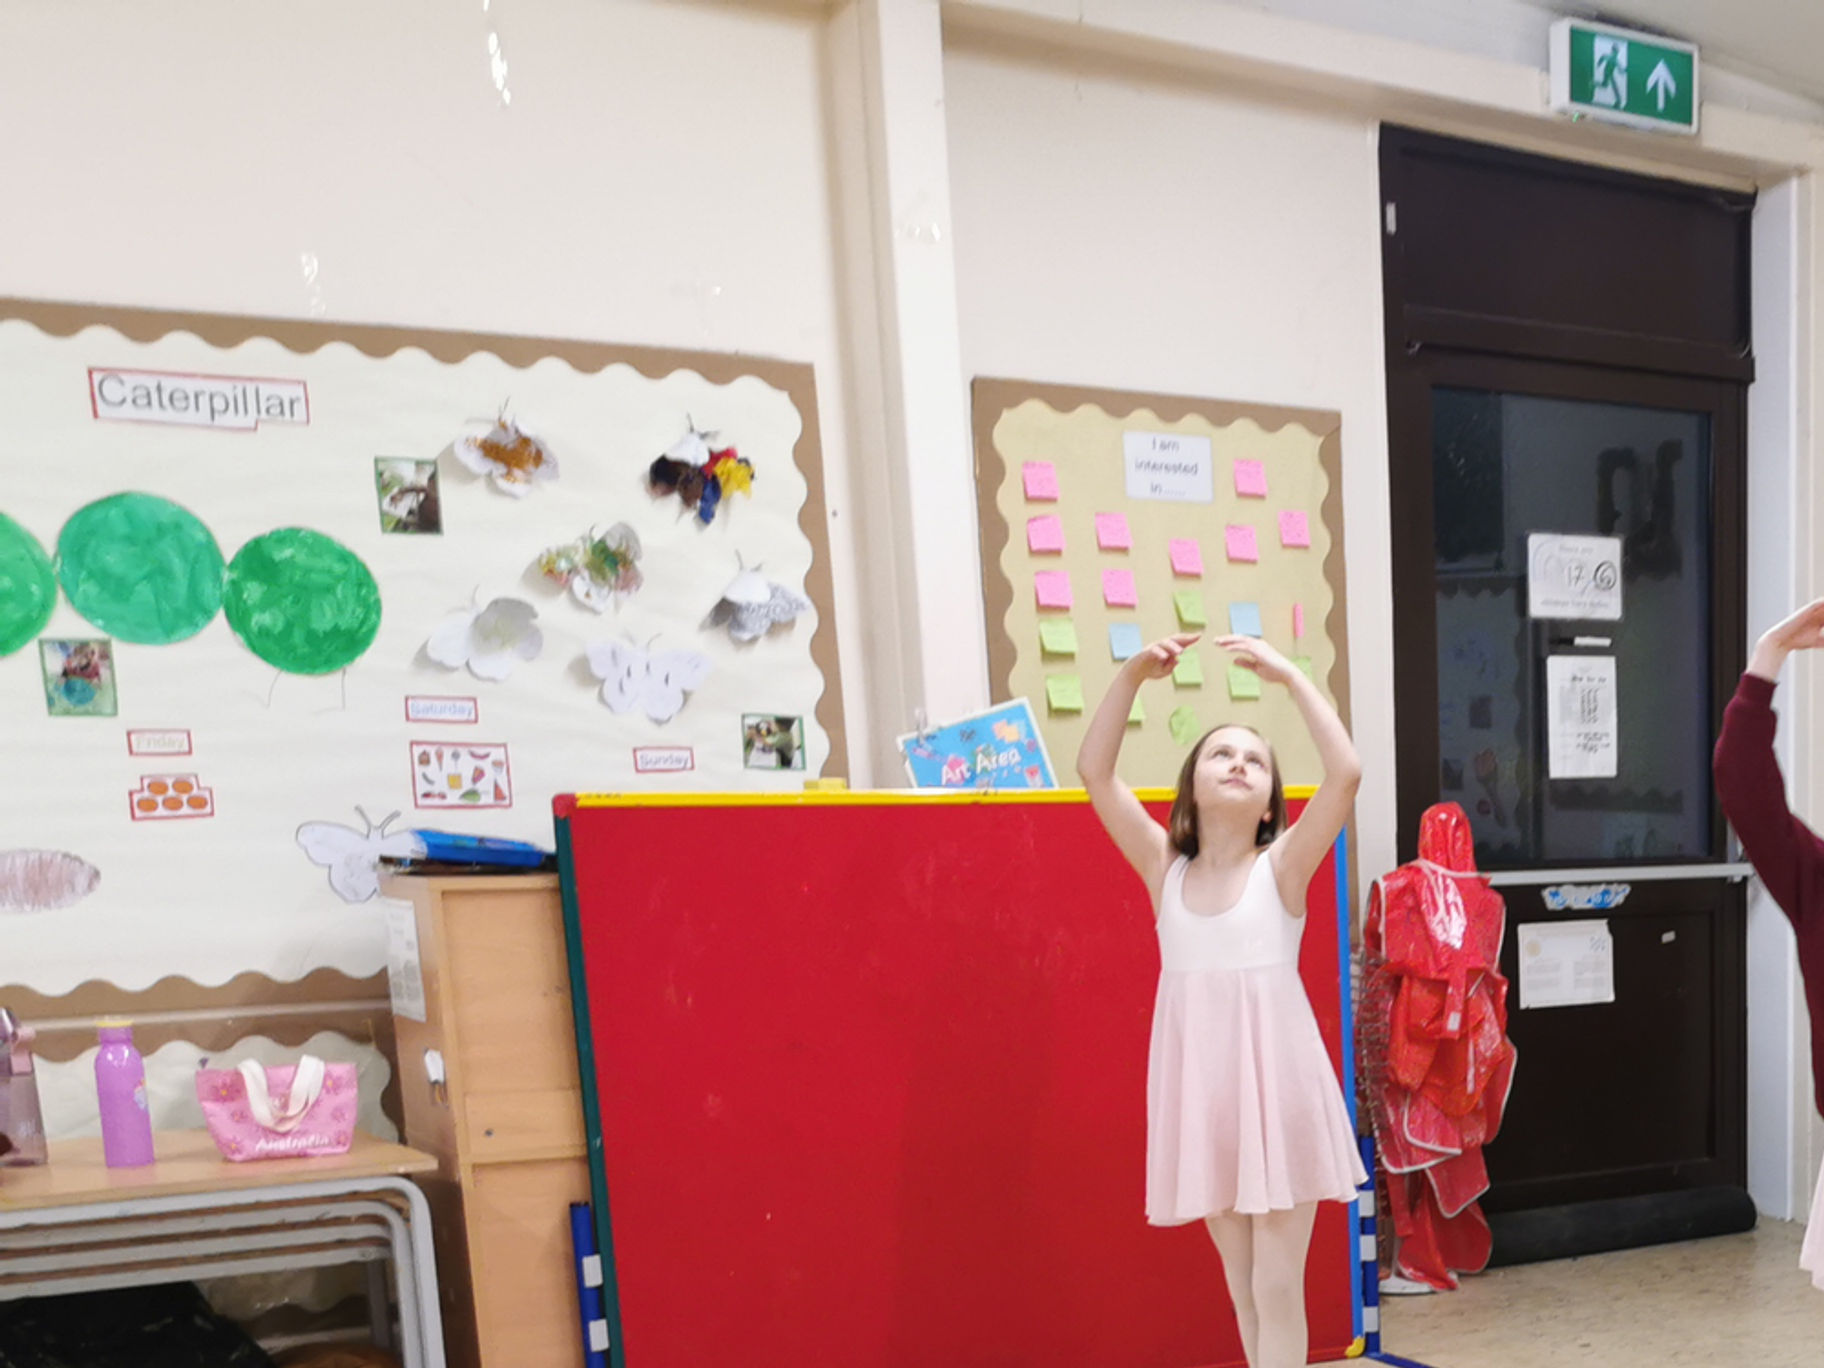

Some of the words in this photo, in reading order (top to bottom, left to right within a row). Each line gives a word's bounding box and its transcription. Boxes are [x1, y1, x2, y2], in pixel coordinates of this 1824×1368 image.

[97, 372, 301, 422] Caterpillar
[1159, 439, 1180, 452] am
[1134, 458, 1199, 475] interested
[976, 748, 1022, 774] Area
